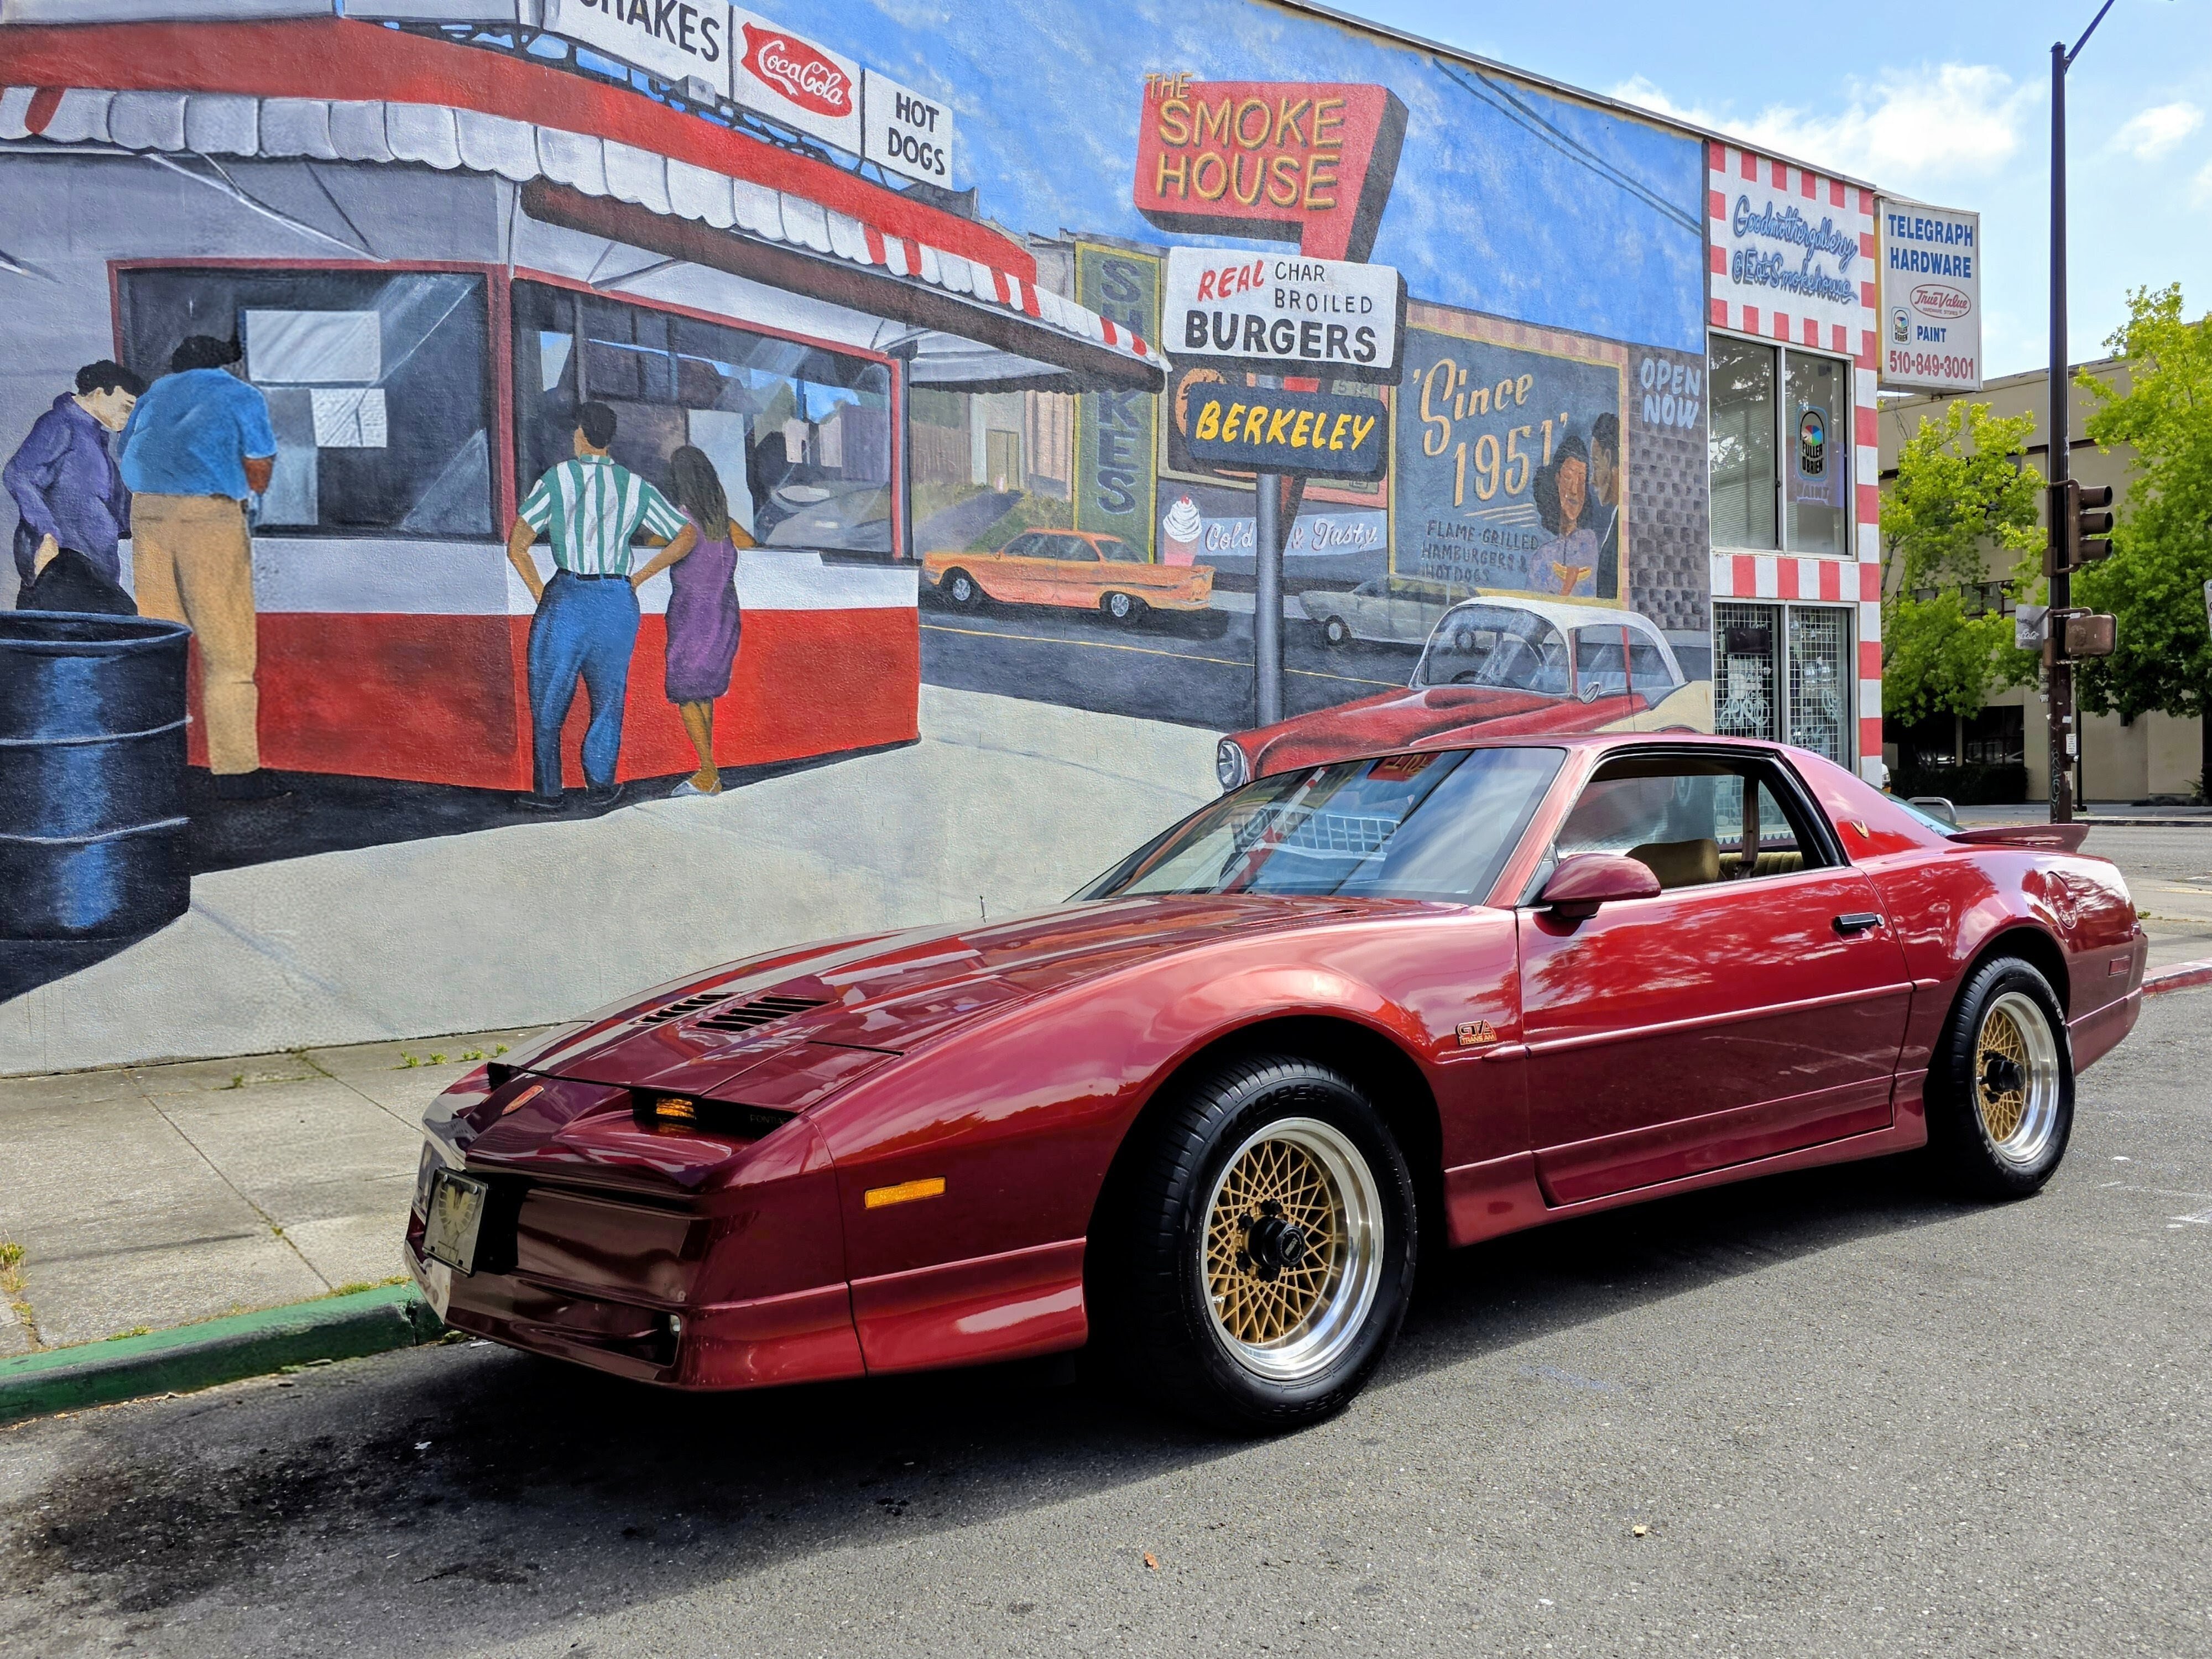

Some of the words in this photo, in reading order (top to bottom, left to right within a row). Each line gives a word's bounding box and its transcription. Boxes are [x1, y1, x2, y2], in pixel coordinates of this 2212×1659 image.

[580, 0, 721, 62] AKES
[1145, 72, 1193, 100] THE
[895, 92, 940, 133] HOT
[1159, 97, 1347, 149] SMOKE
[888, 127, 946, 176] DOGS
[1156, 152, 1340, 210] HOUSE
[1888, 214, 1973, 247] TELEGRAPH
[1890, 247, 1971, 278] HARDWARE
[1198, 259, 1265, 302] REAL
[1275, 261, 1326, 283] CHAR
[1275, 288, 1373, 314] BROILED
[1914, 290, 1938, 305] True
[1933, 292, 1968, 309] Value
[1185, 310, 1376, 363] BURGERS
[1917, 325, 1947, 343] PAINT
[1640, 357, 1701, 397] OPEN
[1889, 351, 1974, 380] 510-849-3001
[1196, 400, 1375, 451] BERKELEY
[1642, 393, 1699, 429] NOW
[1802, 440, 1823, 458] FULLER
[1205, 520, 1254, 551] Cold
[1291, 528, 1305, 549] &
[1312, 518, 1377, 552] Tasty
[1422, 540, 1514, 571] HAMBURGERS
[1457, 1020, 1494, 1036] GTA
[1461, 1036, 1483, 1044] TRANS
